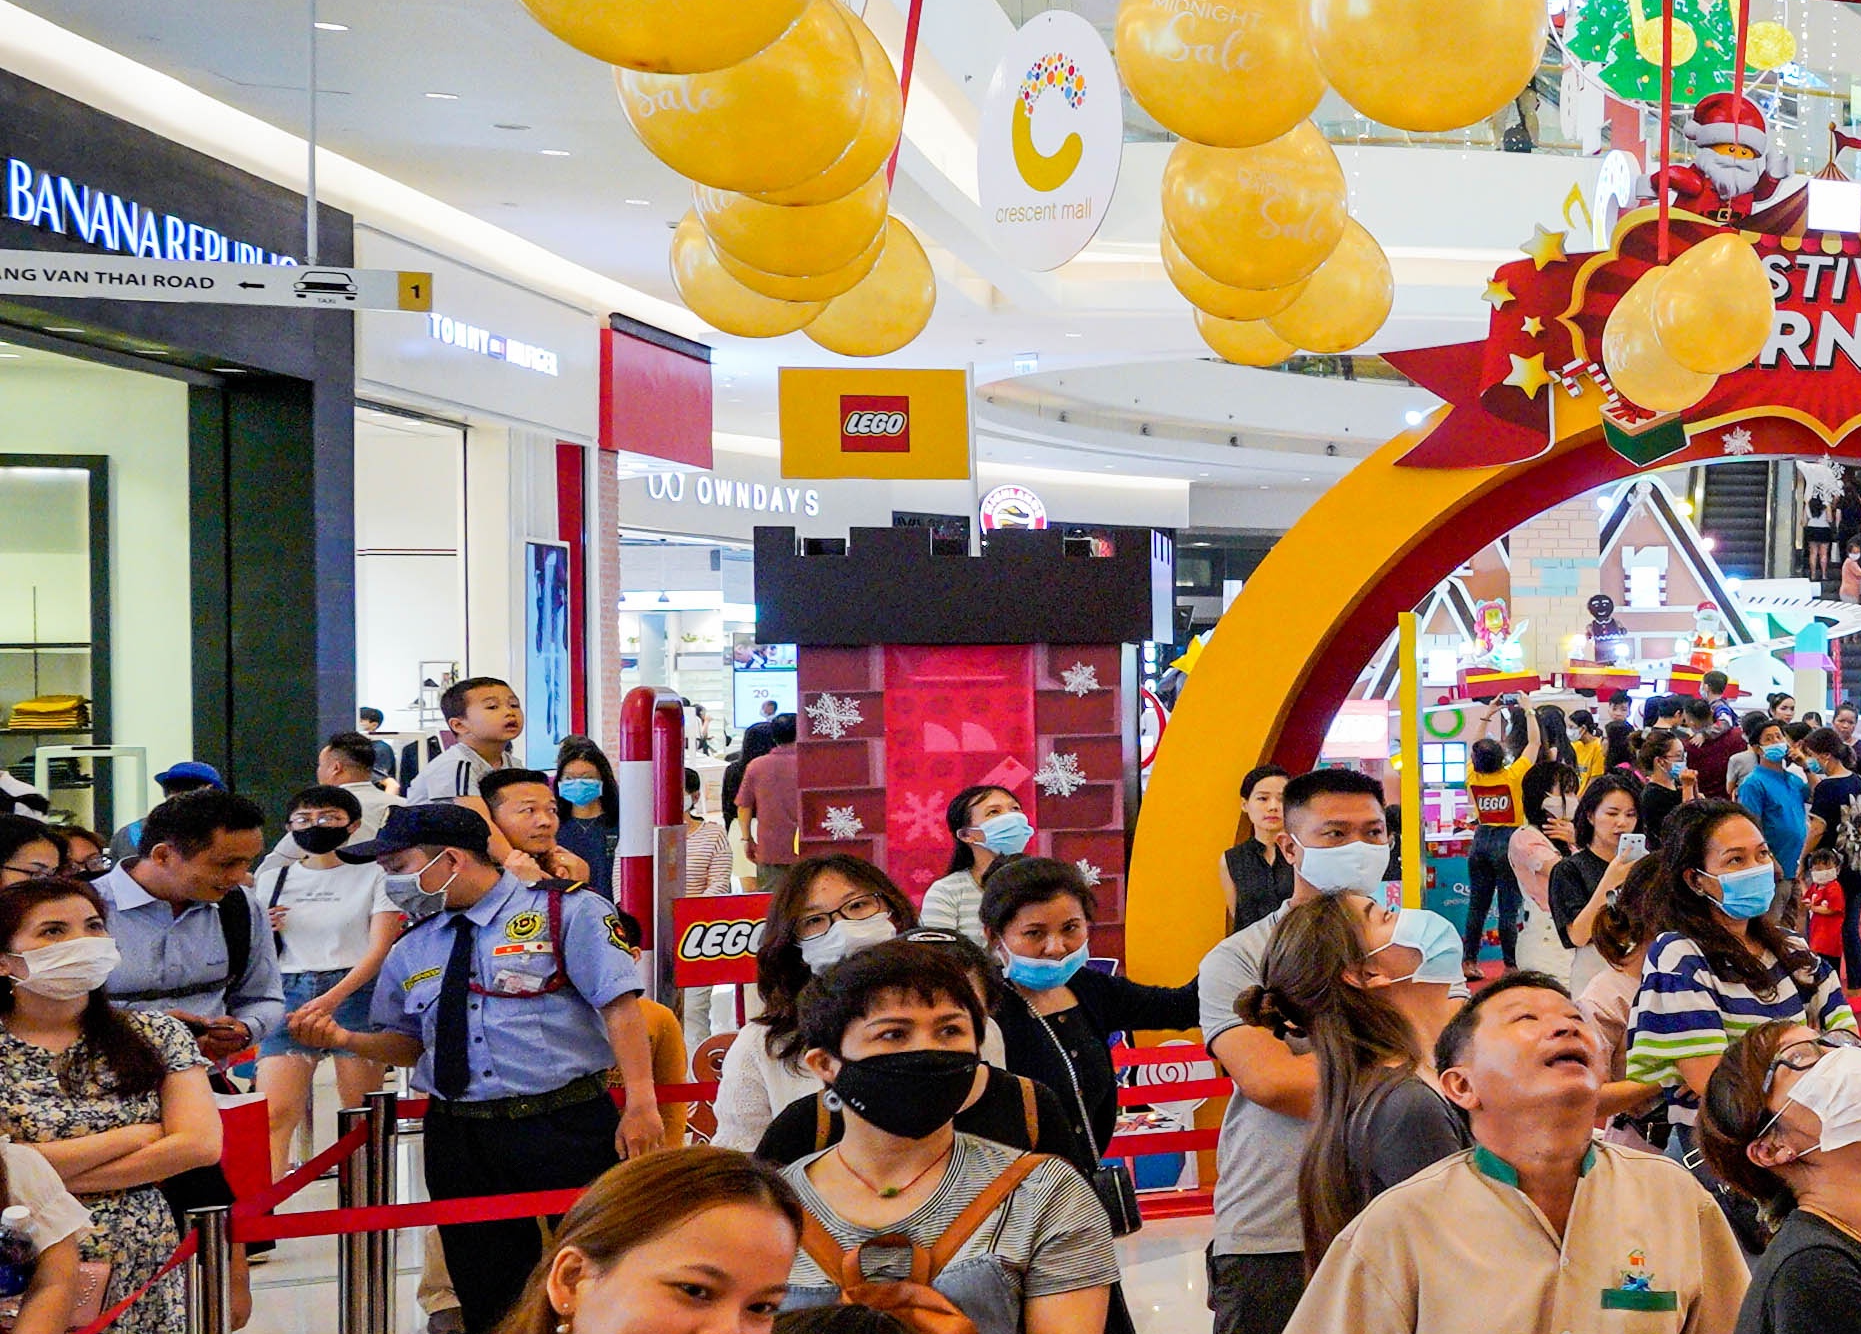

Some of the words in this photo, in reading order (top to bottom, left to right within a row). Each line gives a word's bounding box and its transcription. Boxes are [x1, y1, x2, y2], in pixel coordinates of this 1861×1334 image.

[1169, 11, 1253, 73] Sale
[0, 267, 37, 282] NG
[43, 269, 88, 284] VAN
[95, 271, 146, 287] THAI
[152, 272, 214, 289] ROAD
[409, 283, 421, 299] 1
[430, 313, 489, 355] TOMMY
[844, 412, 906, 436] LEGO
[697, 477, 820, 516] OWNDAYS
[1478, 795, 1509, 812] LEGO
